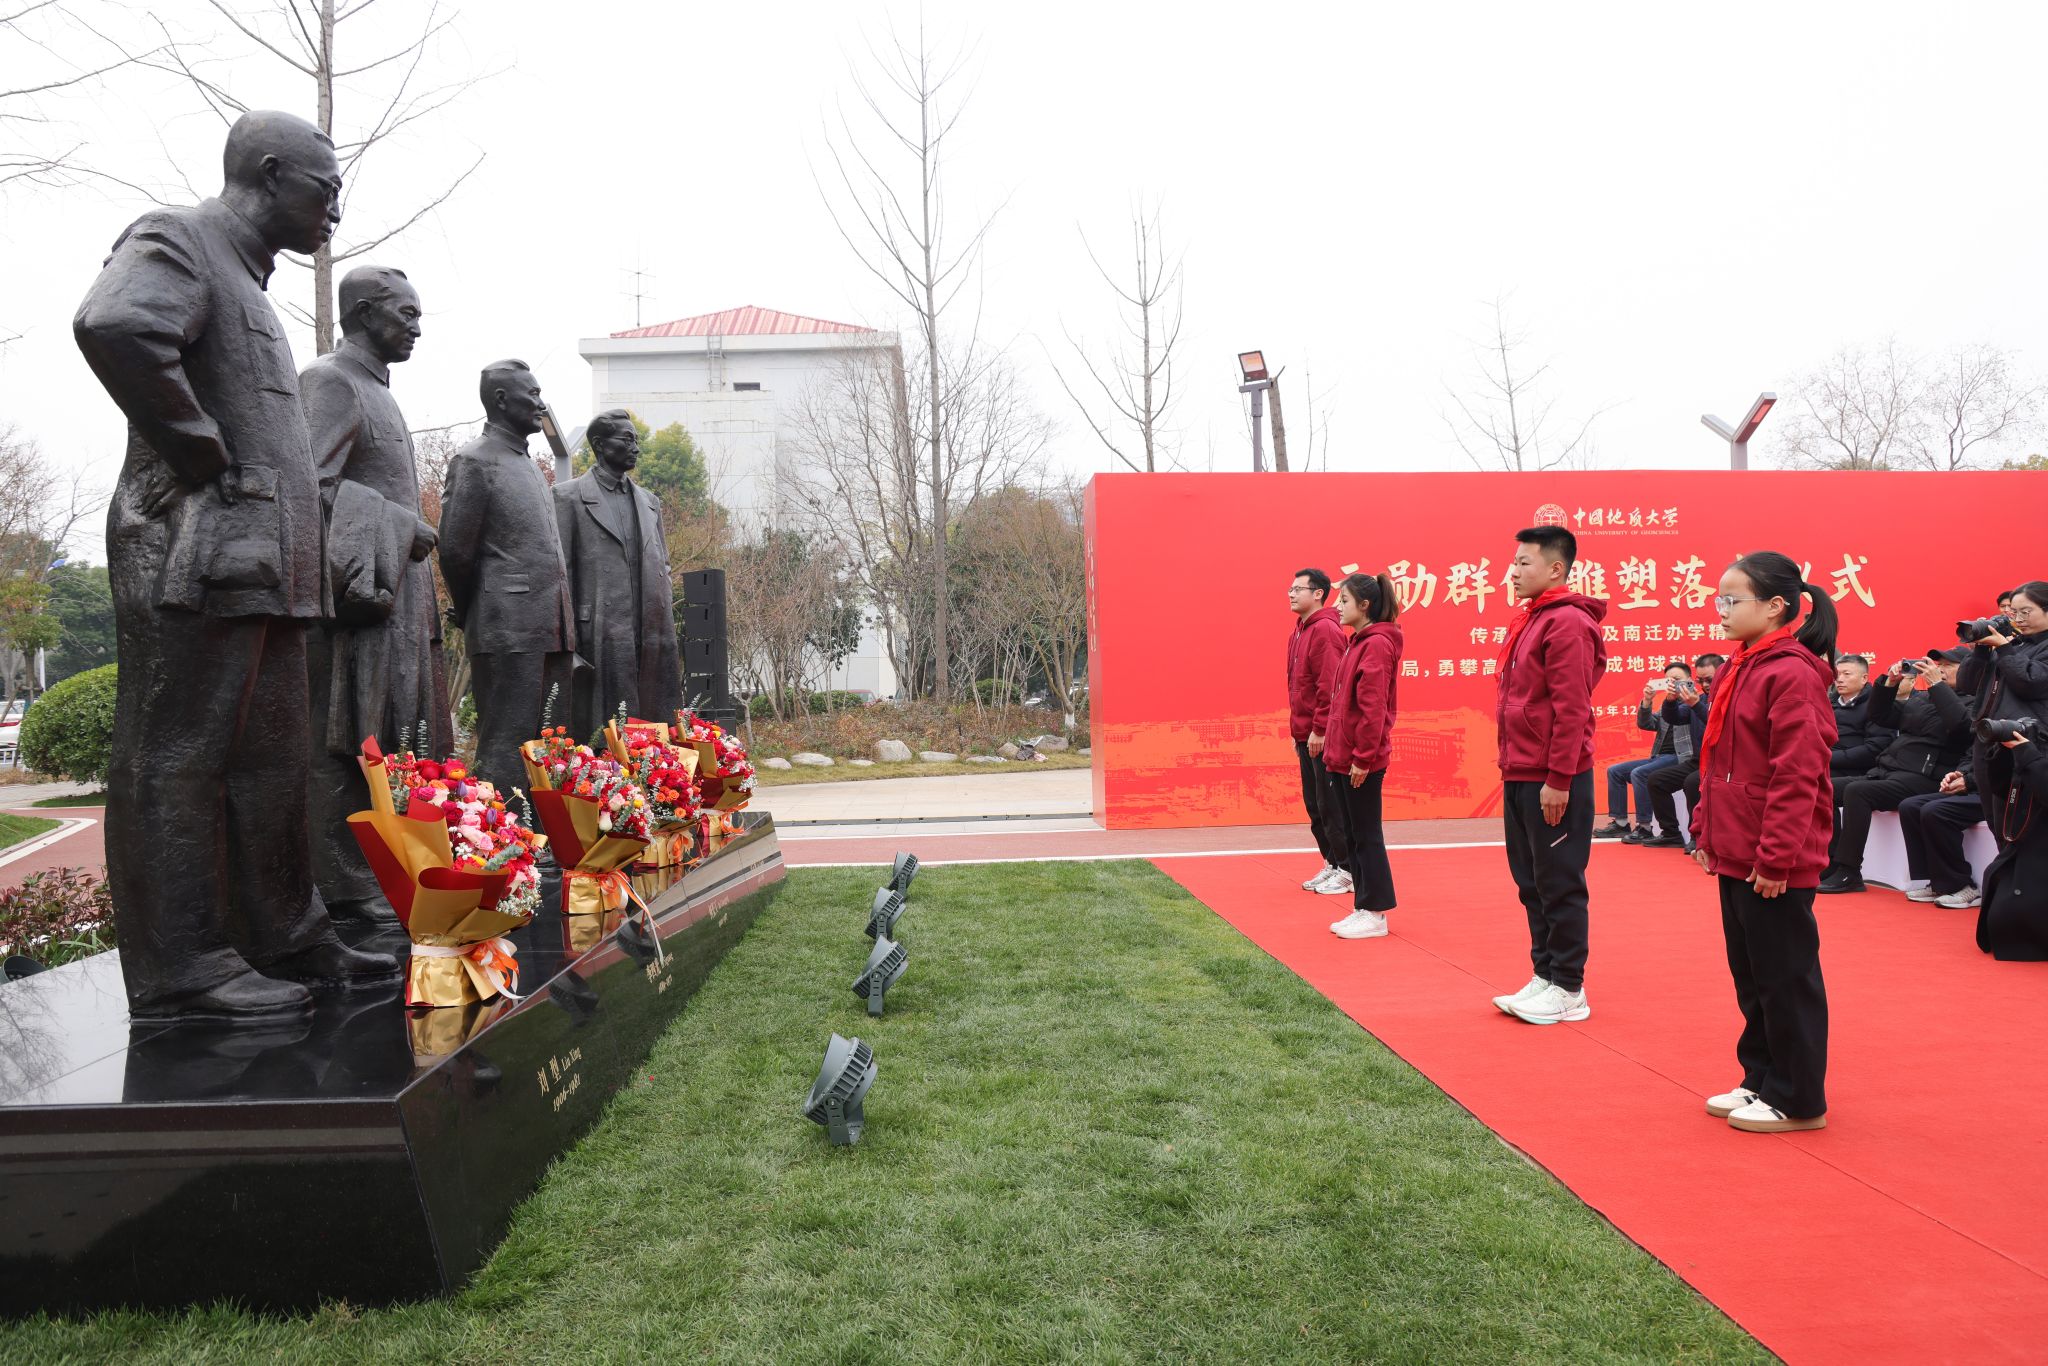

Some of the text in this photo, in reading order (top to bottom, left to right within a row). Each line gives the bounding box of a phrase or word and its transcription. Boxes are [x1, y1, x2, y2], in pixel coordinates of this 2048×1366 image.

[1331, 553, 1876, 614] 勋群雕塑落式
